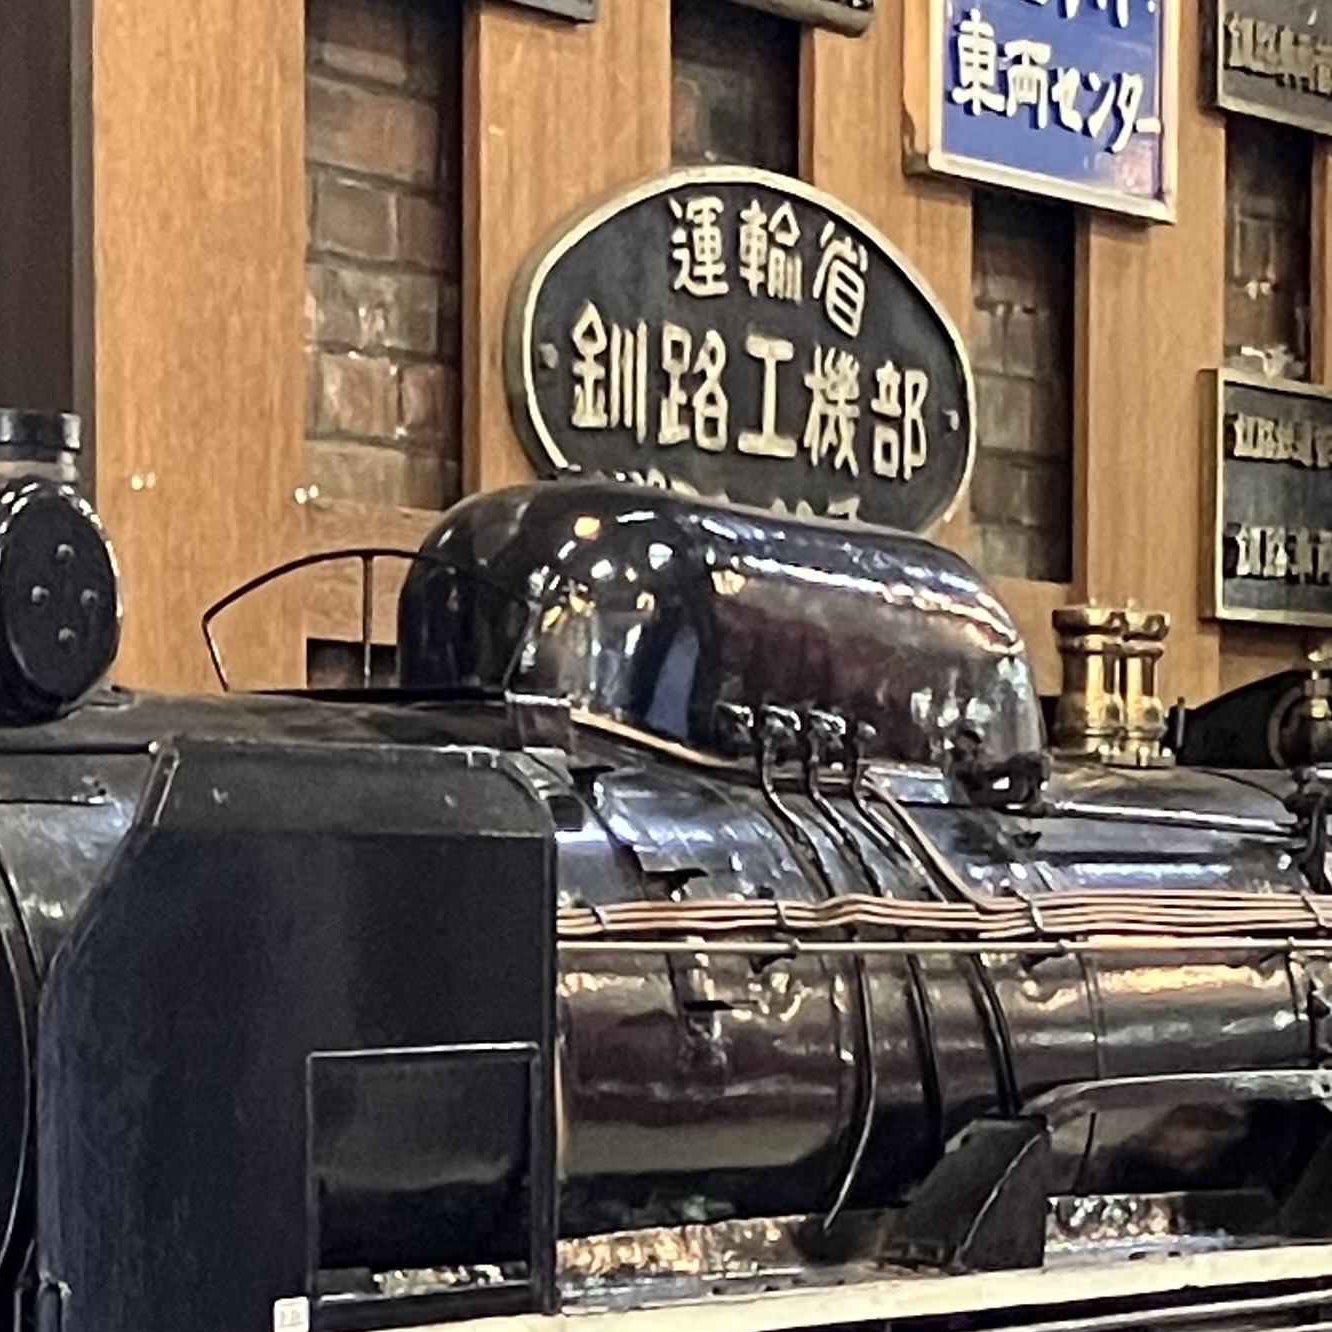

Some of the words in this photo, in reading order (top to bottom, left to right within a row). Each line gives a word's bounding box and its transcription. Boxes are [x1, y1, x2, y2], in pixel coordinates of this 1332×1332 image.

[951, 9, 1163, 154] 車両センター
[668, 195, 868, 338] 運輸省
[571, 299, 930, 481] 釧路工機部
